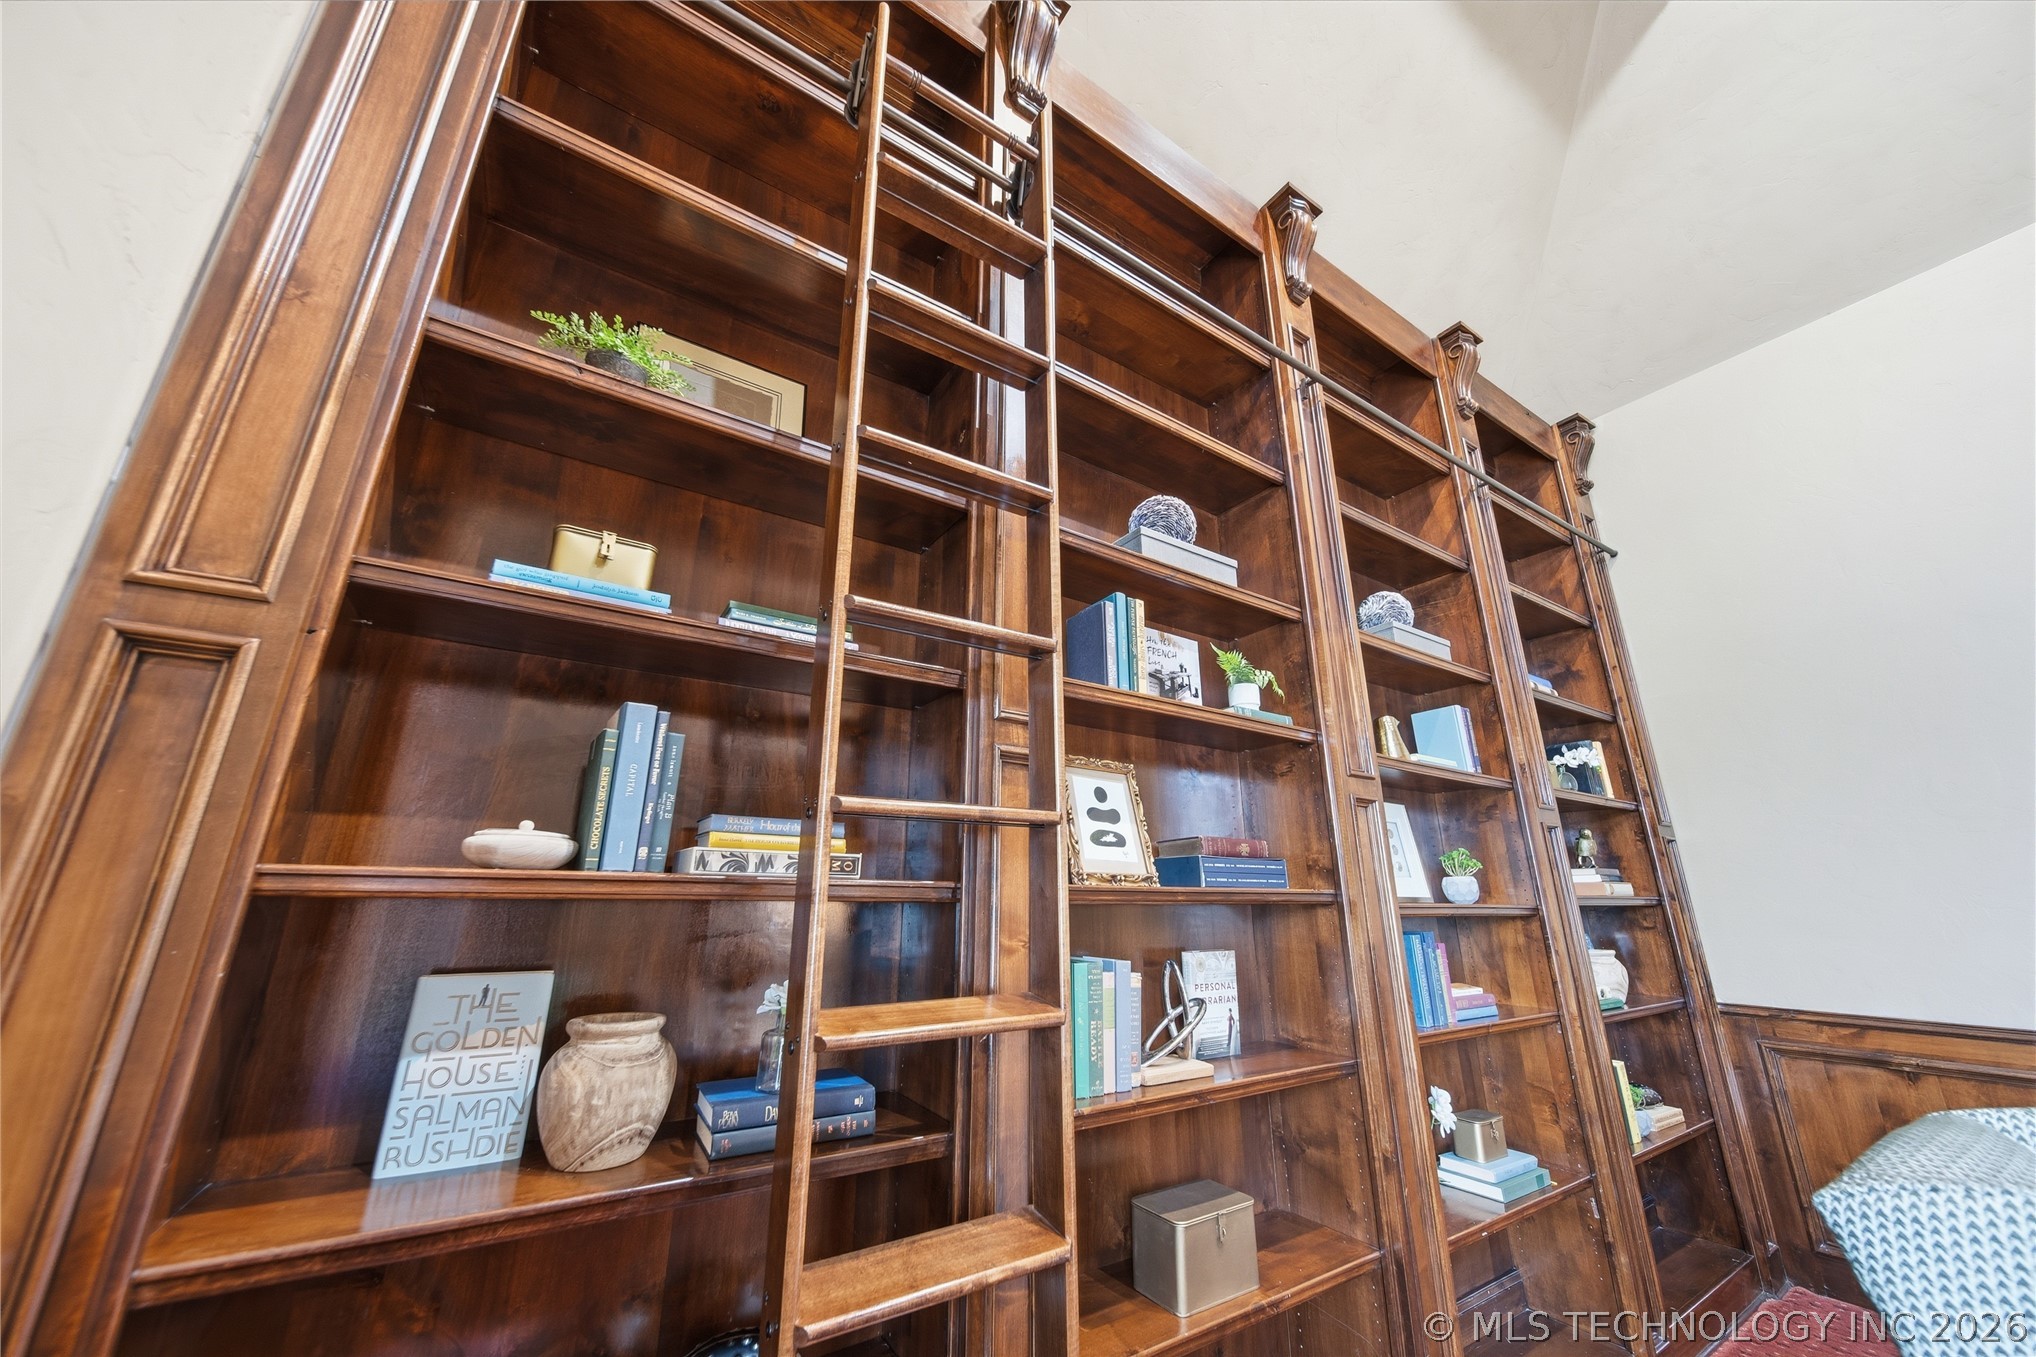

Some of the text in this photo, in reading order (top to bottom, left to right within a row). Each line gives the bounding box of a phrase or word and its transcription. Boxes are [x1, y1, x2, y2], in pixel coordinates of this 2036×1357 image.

[1147, 646, 1177, 659] FRENCH
[625, 763, 638, 797] CAPITAL
[590, 766, 611, 850] CHOCOLATE SECRETS
[665, 793, 675, 811] Plan
[1194, 981, 1236, 992] PERSONAL
[1202, 995, 1237, 1006] RARIAN
[448, 987, 521, 1024] THE
[411, 1016, 542, 1062] GOLDEN
[400, 1056, 518, 1100] HOUSE
[392, 1062, 534, 1138] SALMAN
[382, 1127, 521, 1170] RUSHDIE
